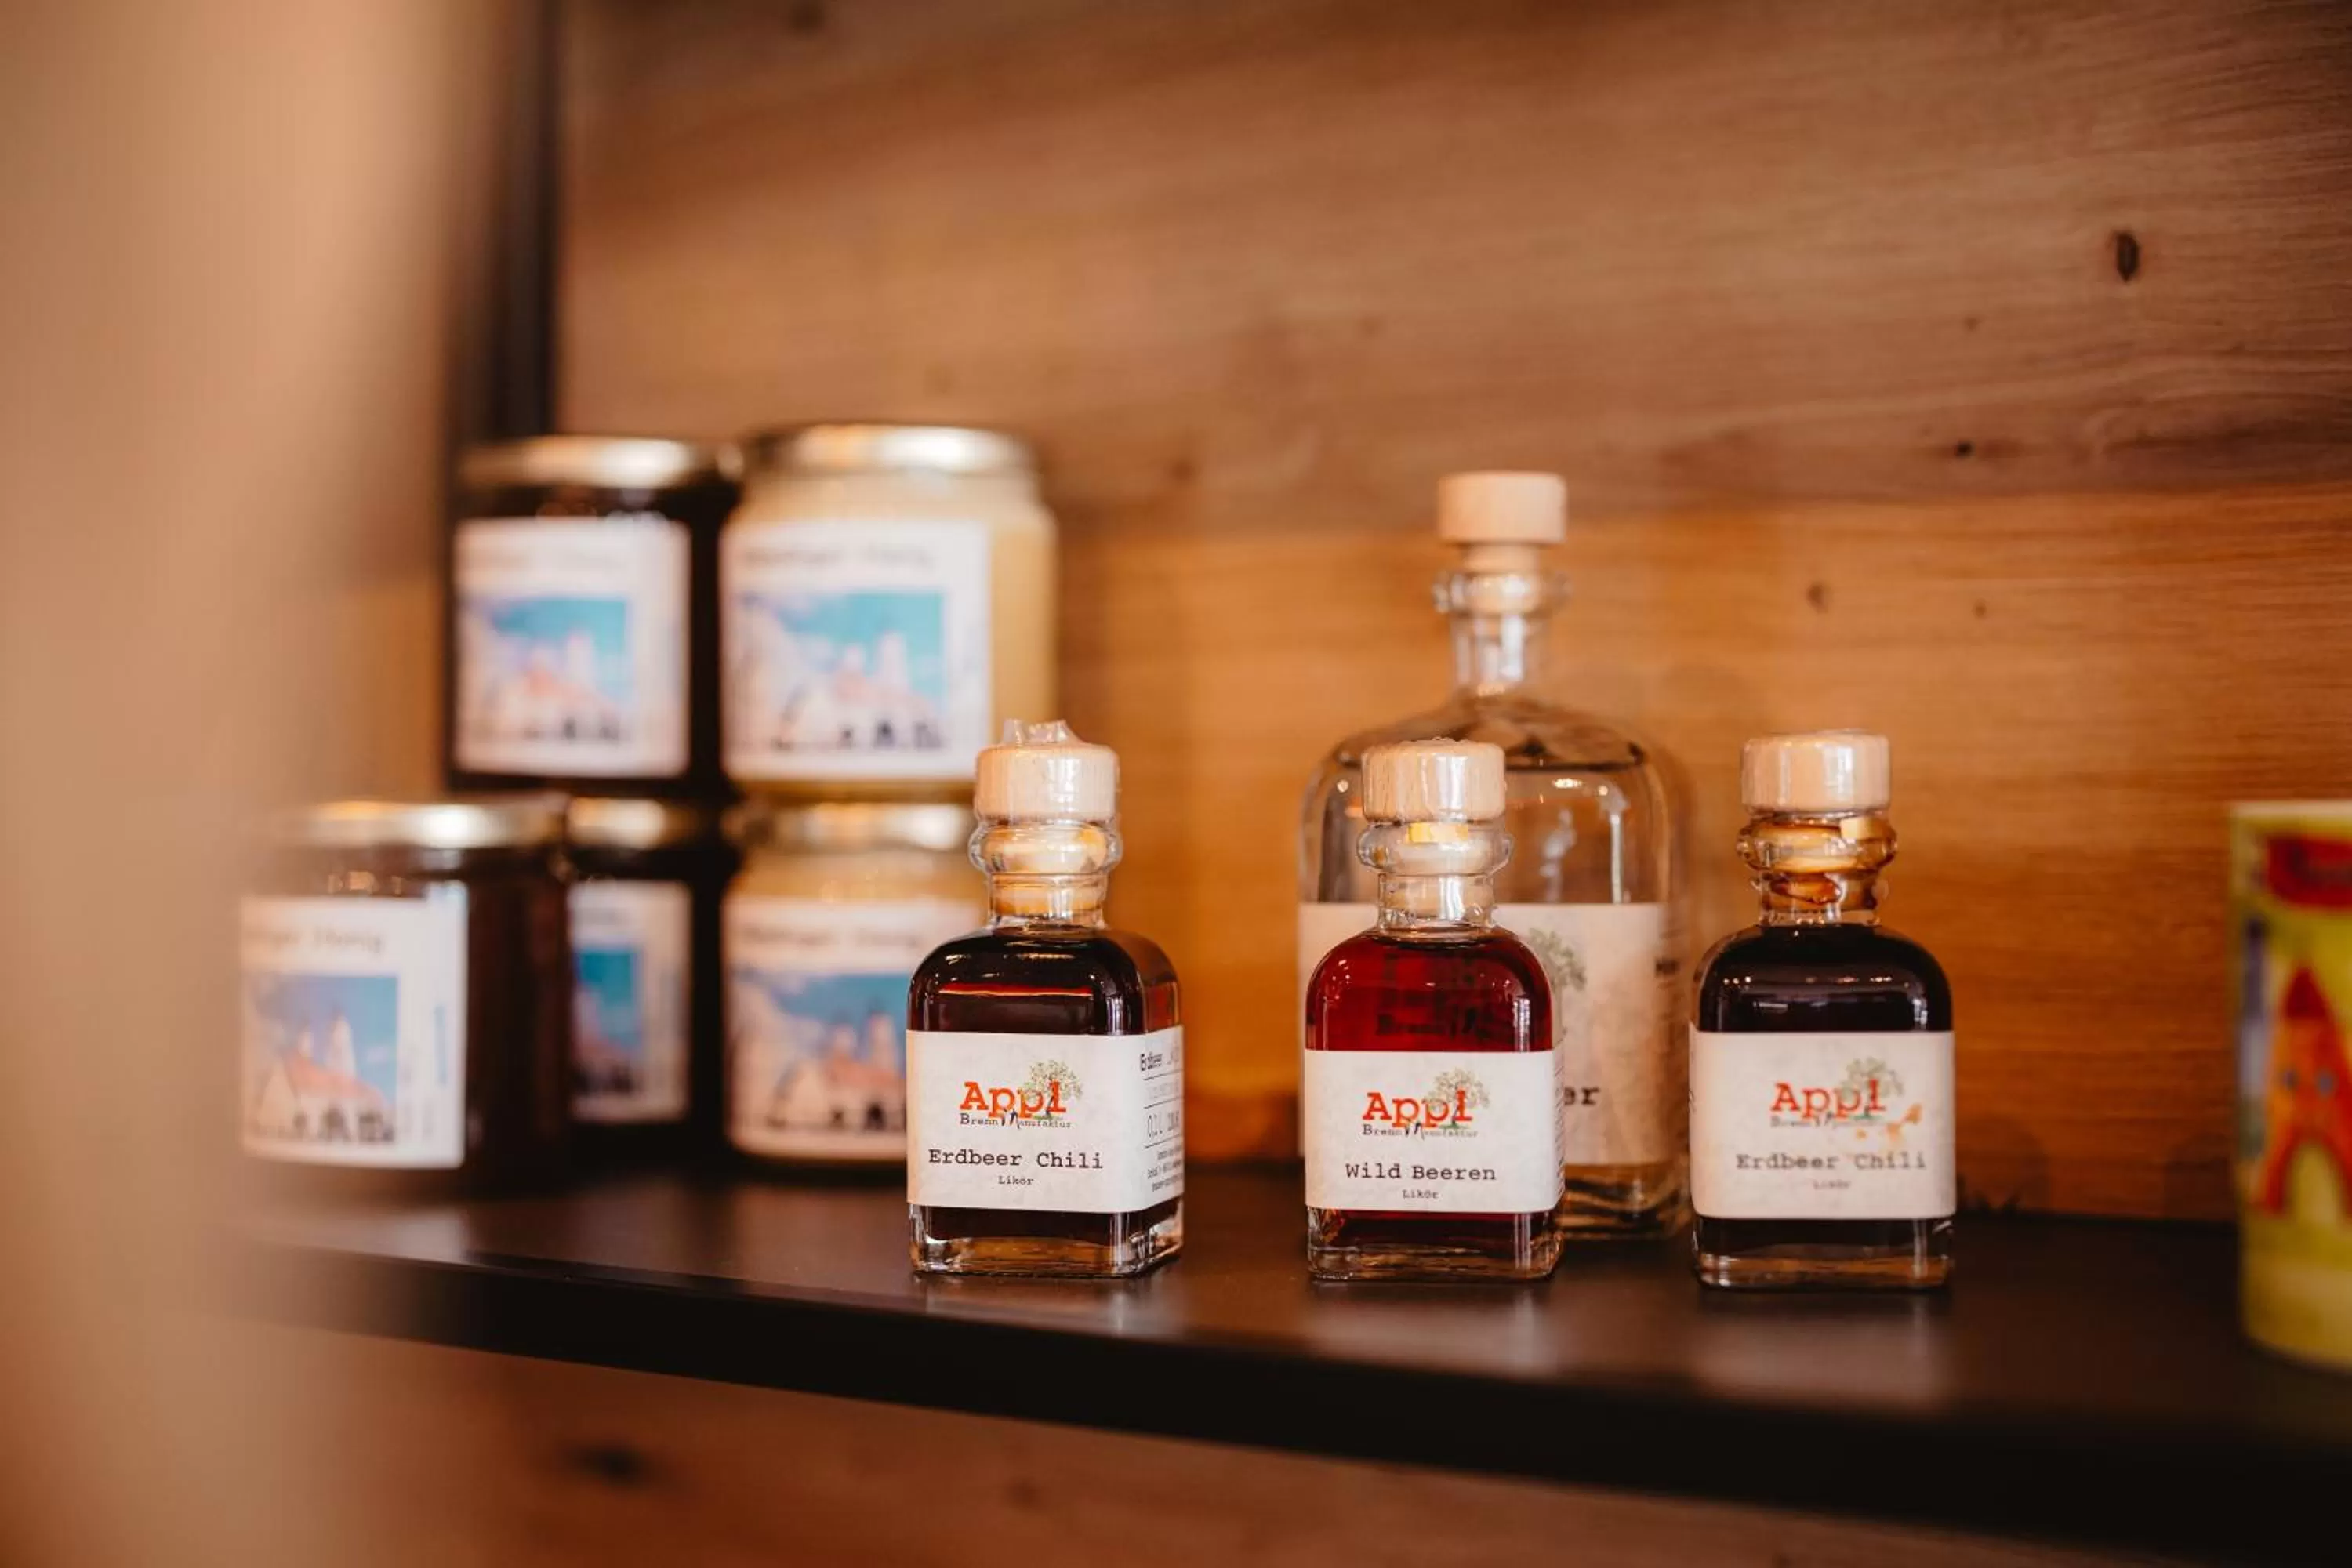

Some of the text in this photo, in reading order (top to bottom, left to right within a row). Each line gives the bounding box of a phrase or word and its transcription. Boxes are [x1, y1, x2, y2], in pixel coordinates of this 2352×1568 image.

[959, 1079, 1067, 1119] Appl
[1362, 1090, 1473, 1127] Appl
[1770, 1079, 1886, 1119] Appl
[928, 1149, 1104, 1169] Erdbeer Chili
[1735, 1151, 1927, 1170] Erdbeer Chili
[997, 1175, 1034, 1185] Likör
[1345, 1163, 1497, 1181] Wild Beeren
